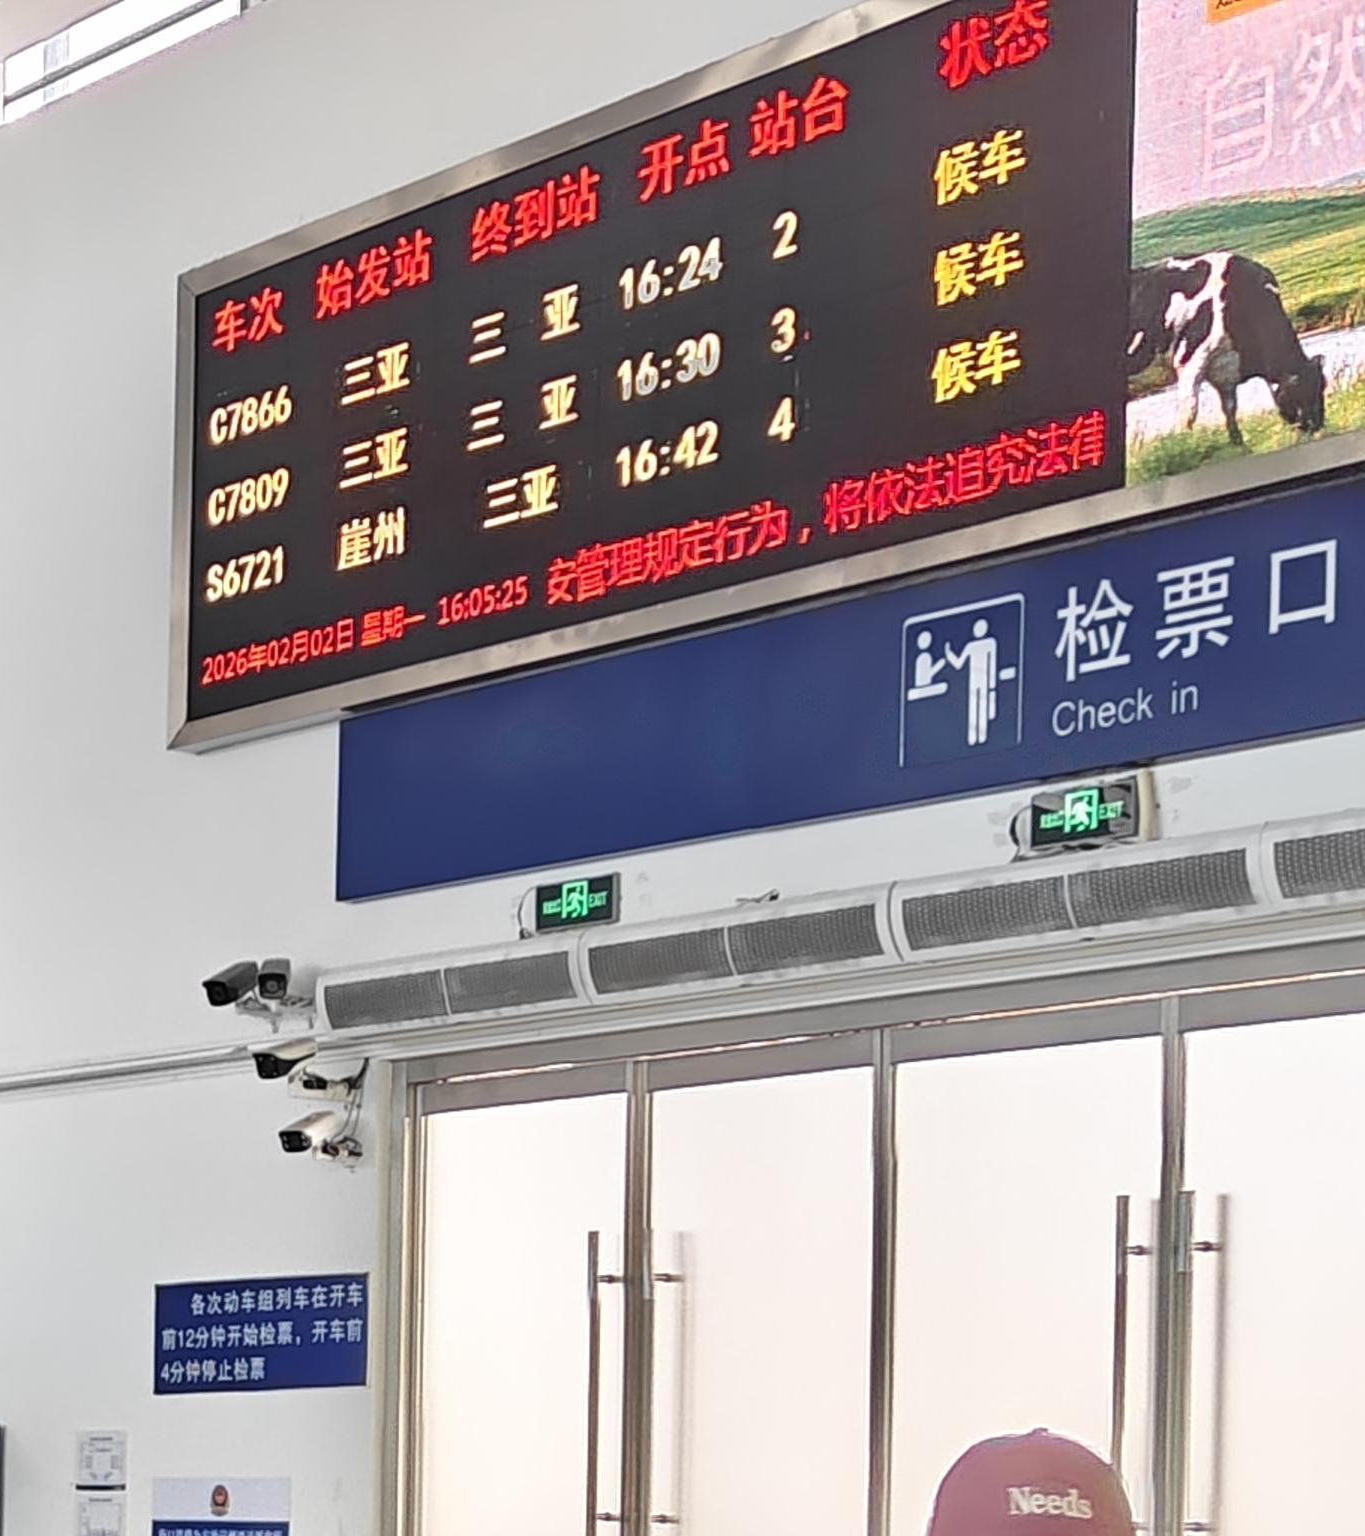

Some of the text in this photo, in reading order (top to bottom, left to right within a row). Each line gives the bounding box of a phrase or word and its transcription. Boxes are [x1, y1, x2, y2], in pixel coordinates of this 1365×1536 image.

[938, 0, 1050, 90] 状态
[211, 78, 848, 352] 车次 始发站 终到站 开点 站台
[209, 388, 291, 446] C7866
[341, 342, 411, 406] 三亚
[619, 237, 723, 309] 16:24
[772, 211, 797, 259] 2
[933, 130, 1026, 205] 候车
[208, 468, 289, 528] C7809
[340, 427, 409, 488] 三亚
[617, 333, 722, 400] 16:30
[771, 307, 796, 354] 3
[933, 232, 1024, 306] 候车
[207, 331, 1021, 603] S6721 崖州 三亚 16:42 4 候车
[202, 575, 528, 685] 2026年02月02日 星期一 16:05:25
[1055, 539, 1338, 683] 检票口
[1051, 681, 1199, 737] Check in
[191, 1282, 363, 1316] 各次动车组列车在开车
[161, 1357, 266, 1384] 4分钟停止检票
[1007, 1487, 1093, 1519] Needs
